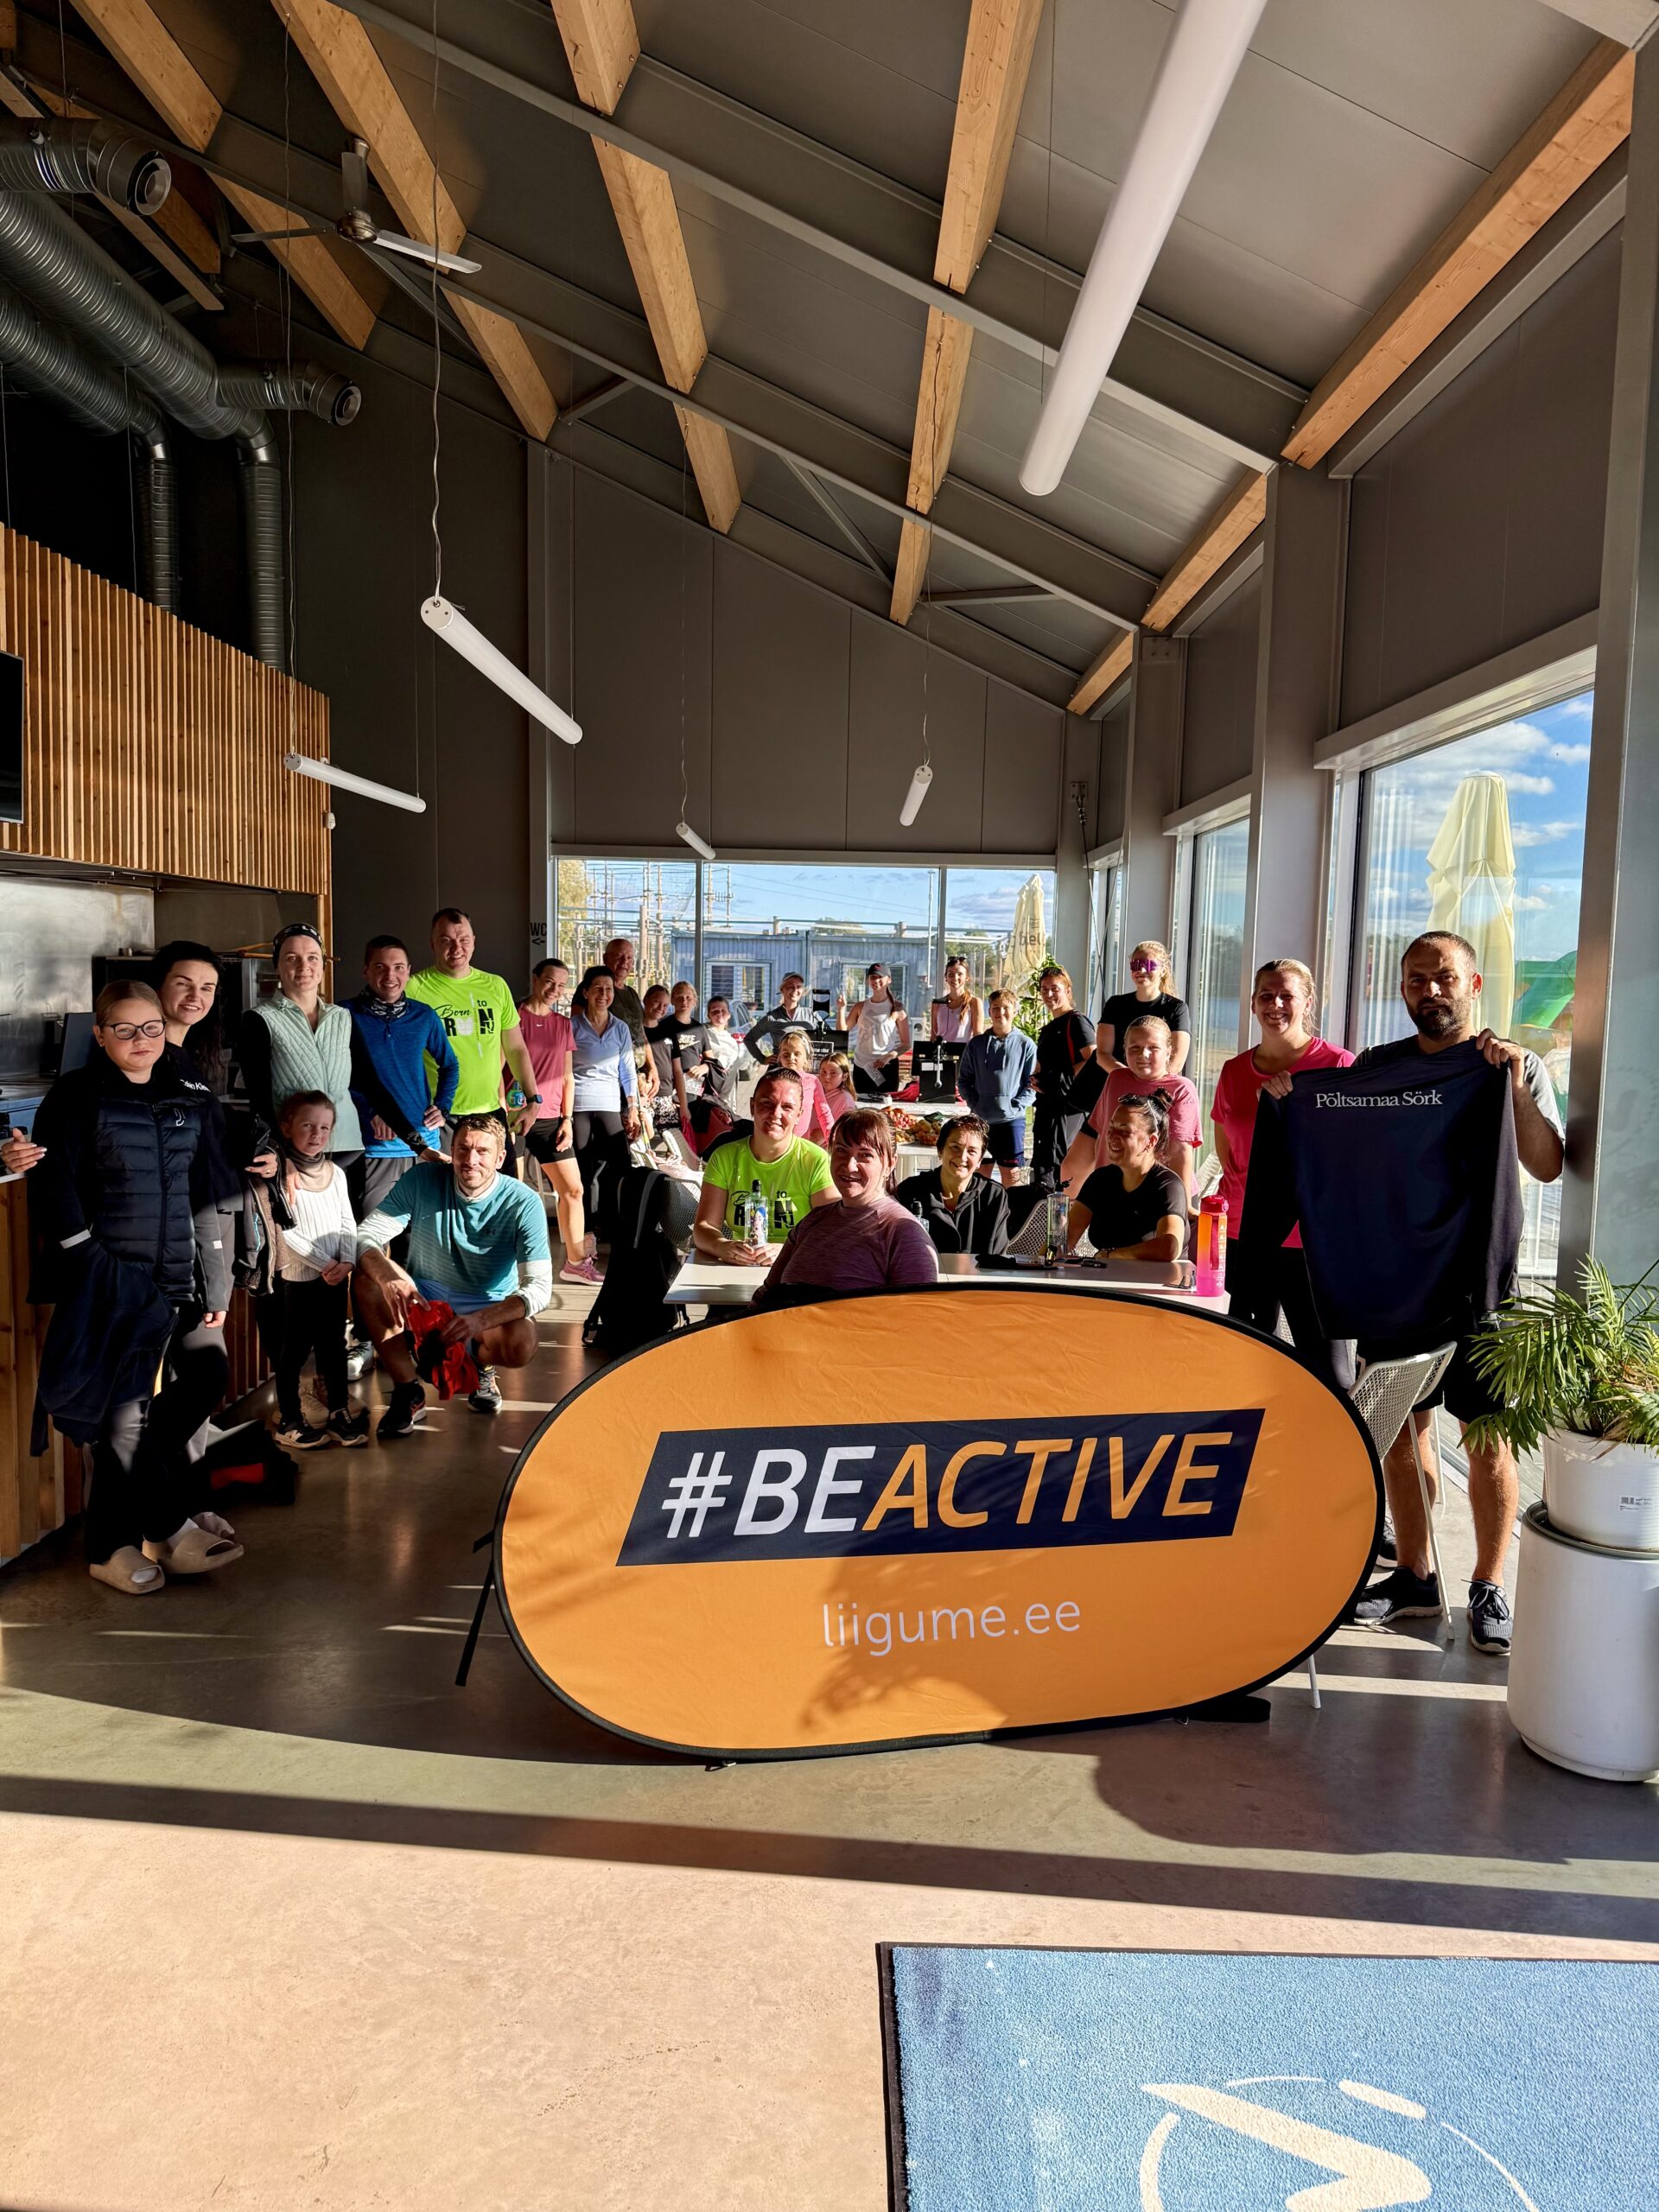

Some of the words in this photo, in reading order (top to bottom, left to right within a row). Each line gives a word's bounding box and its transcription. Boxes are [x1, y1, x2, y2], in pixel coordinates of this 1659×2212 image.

[530, 922, 547, 937] WC
[435, 1004, 472, 1019] Born
[477, 999, 487, 1007] to
[1315, 1091, 1400, 1109] Põltsamaa
[1402, 1089, 1443, 1106] Sörk
[661, 1431, 1233, 1539] #BEACTIVE
[823, 1600, 1081, 1657] liigume.ee
